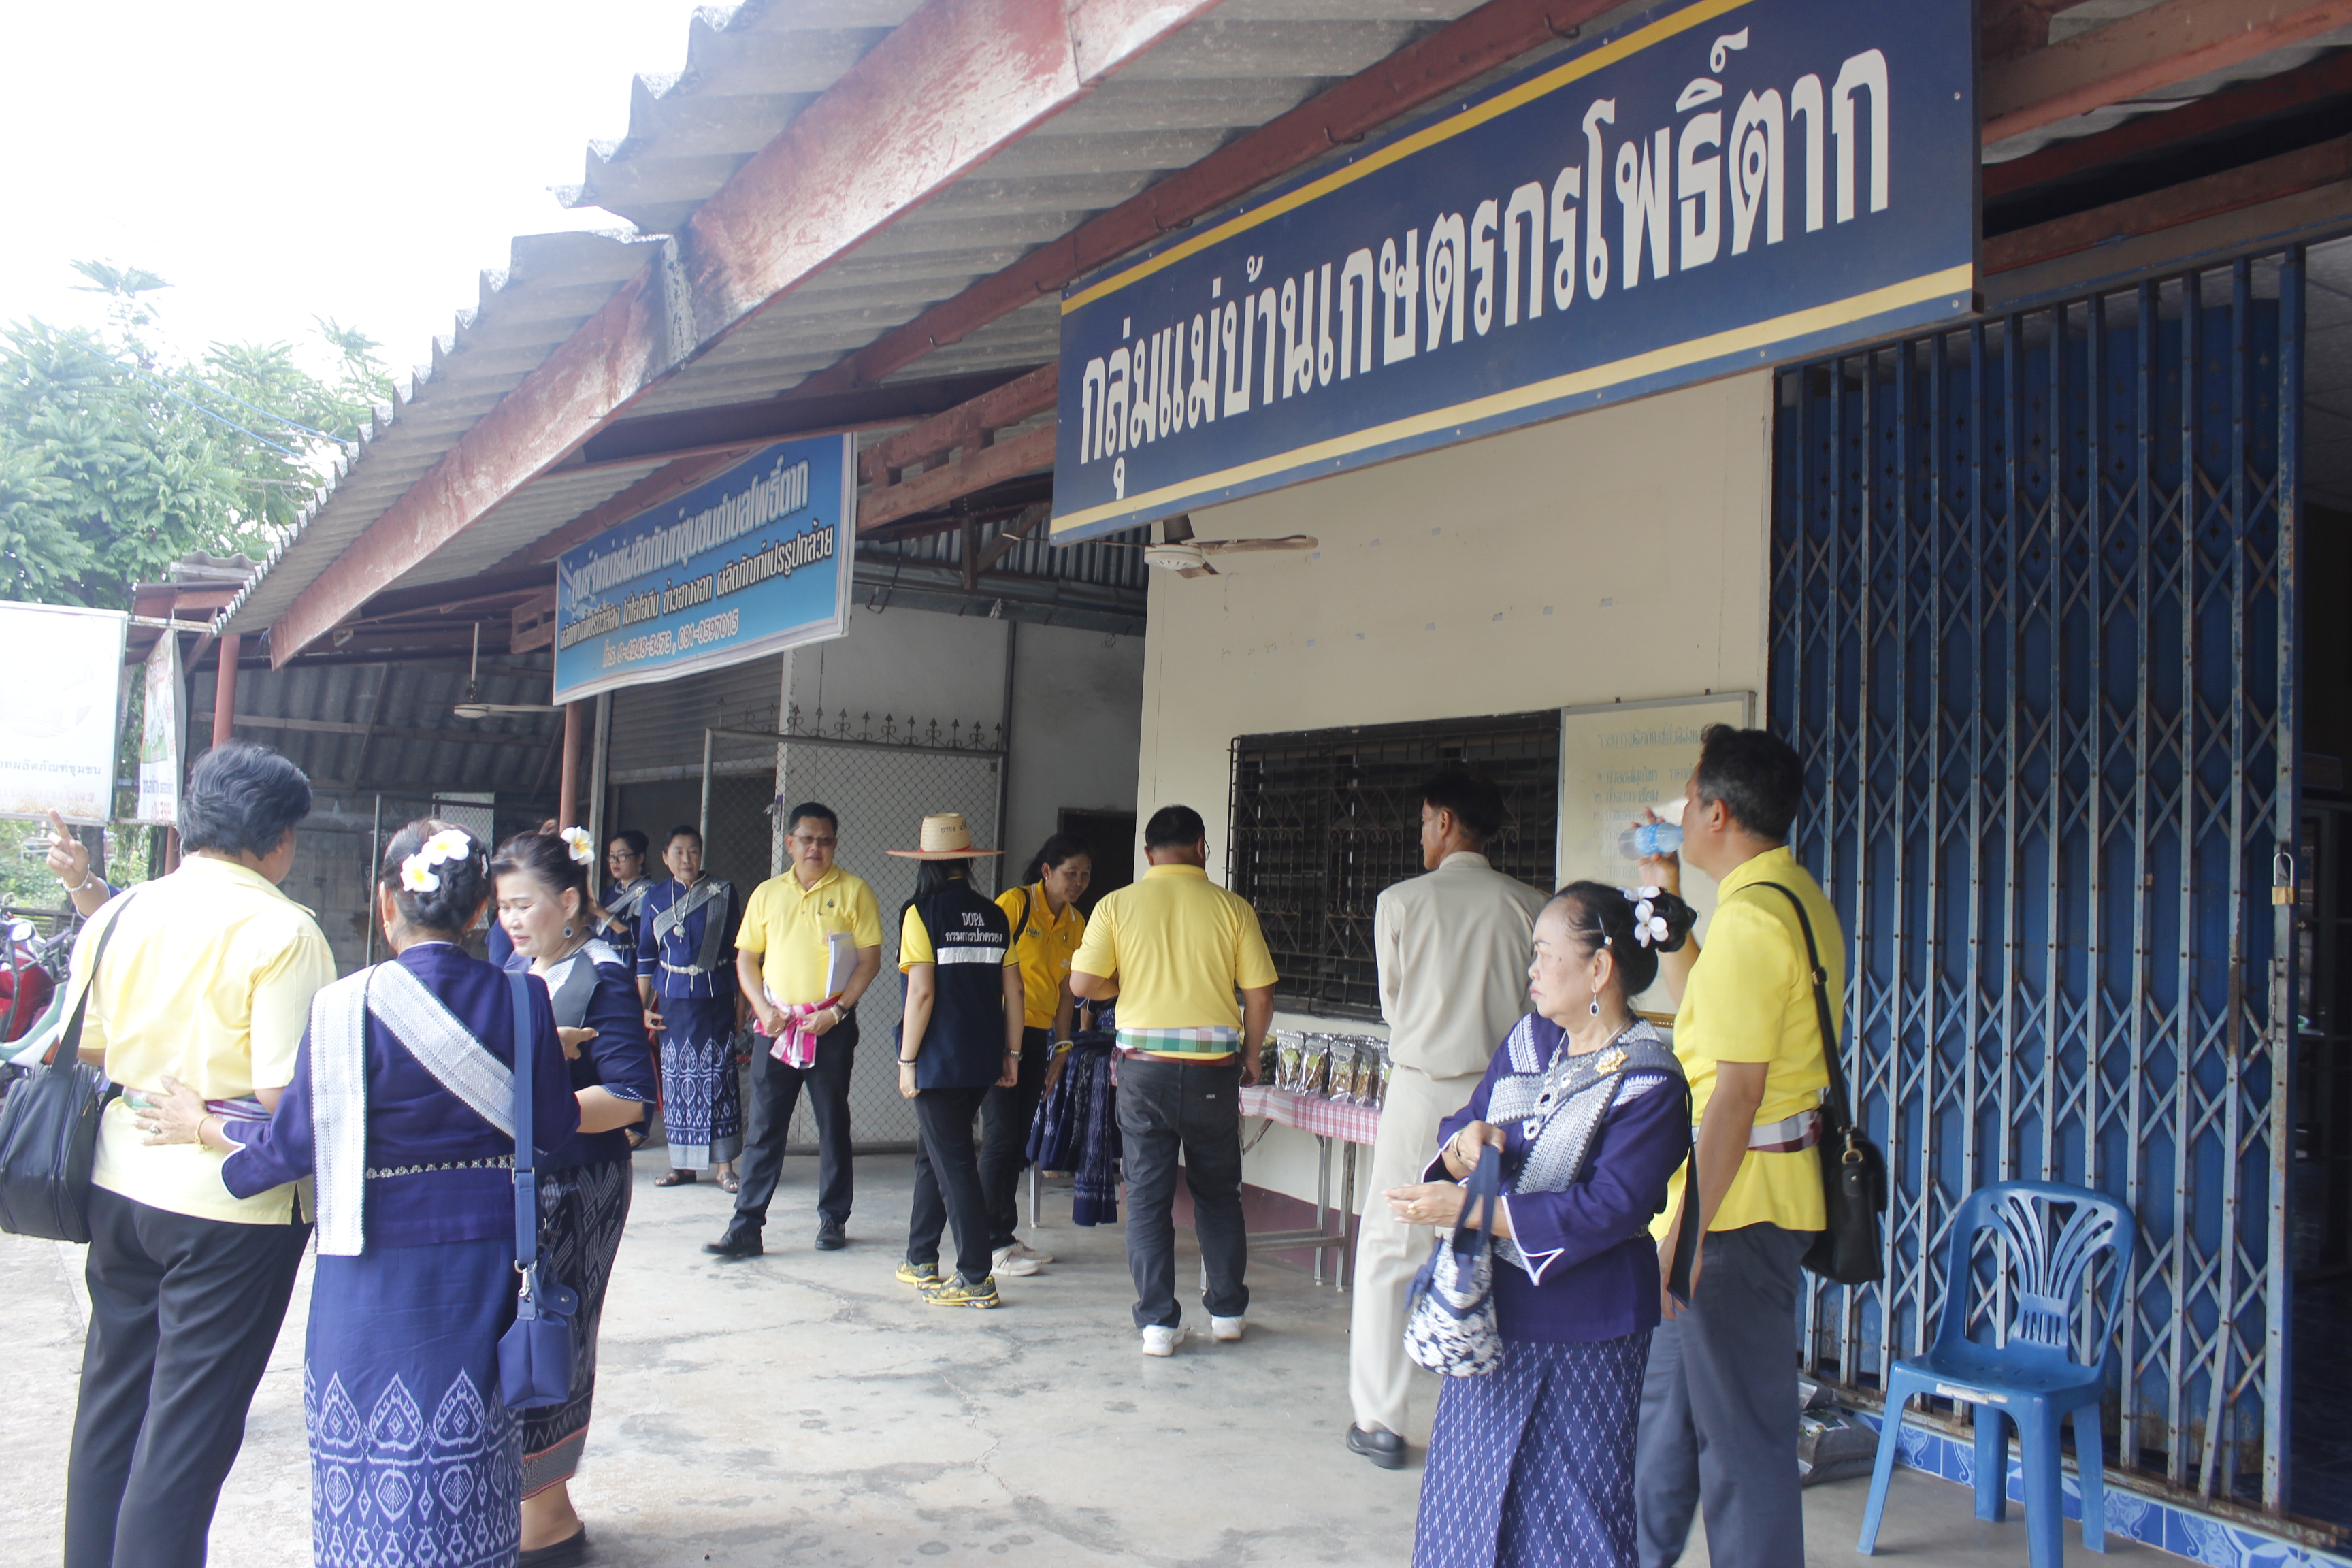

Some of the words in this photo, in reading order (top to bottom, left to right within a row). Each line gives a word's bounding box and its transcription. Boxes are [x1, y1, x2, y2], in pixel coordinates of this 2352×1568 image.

[1081, 27, 1890, 500] กลุ่มแม่บ้านเกษตรกรโพธิ์ตาก
[717, 518, 834, 600] ผลิตภัณฑ์แปรรูปกล้วย
[677, 608, 739, 651] 081-0597015
[945, 927, 1003, 943] กรมการปกครอง
[962, 912, 985, 926] DOPA
